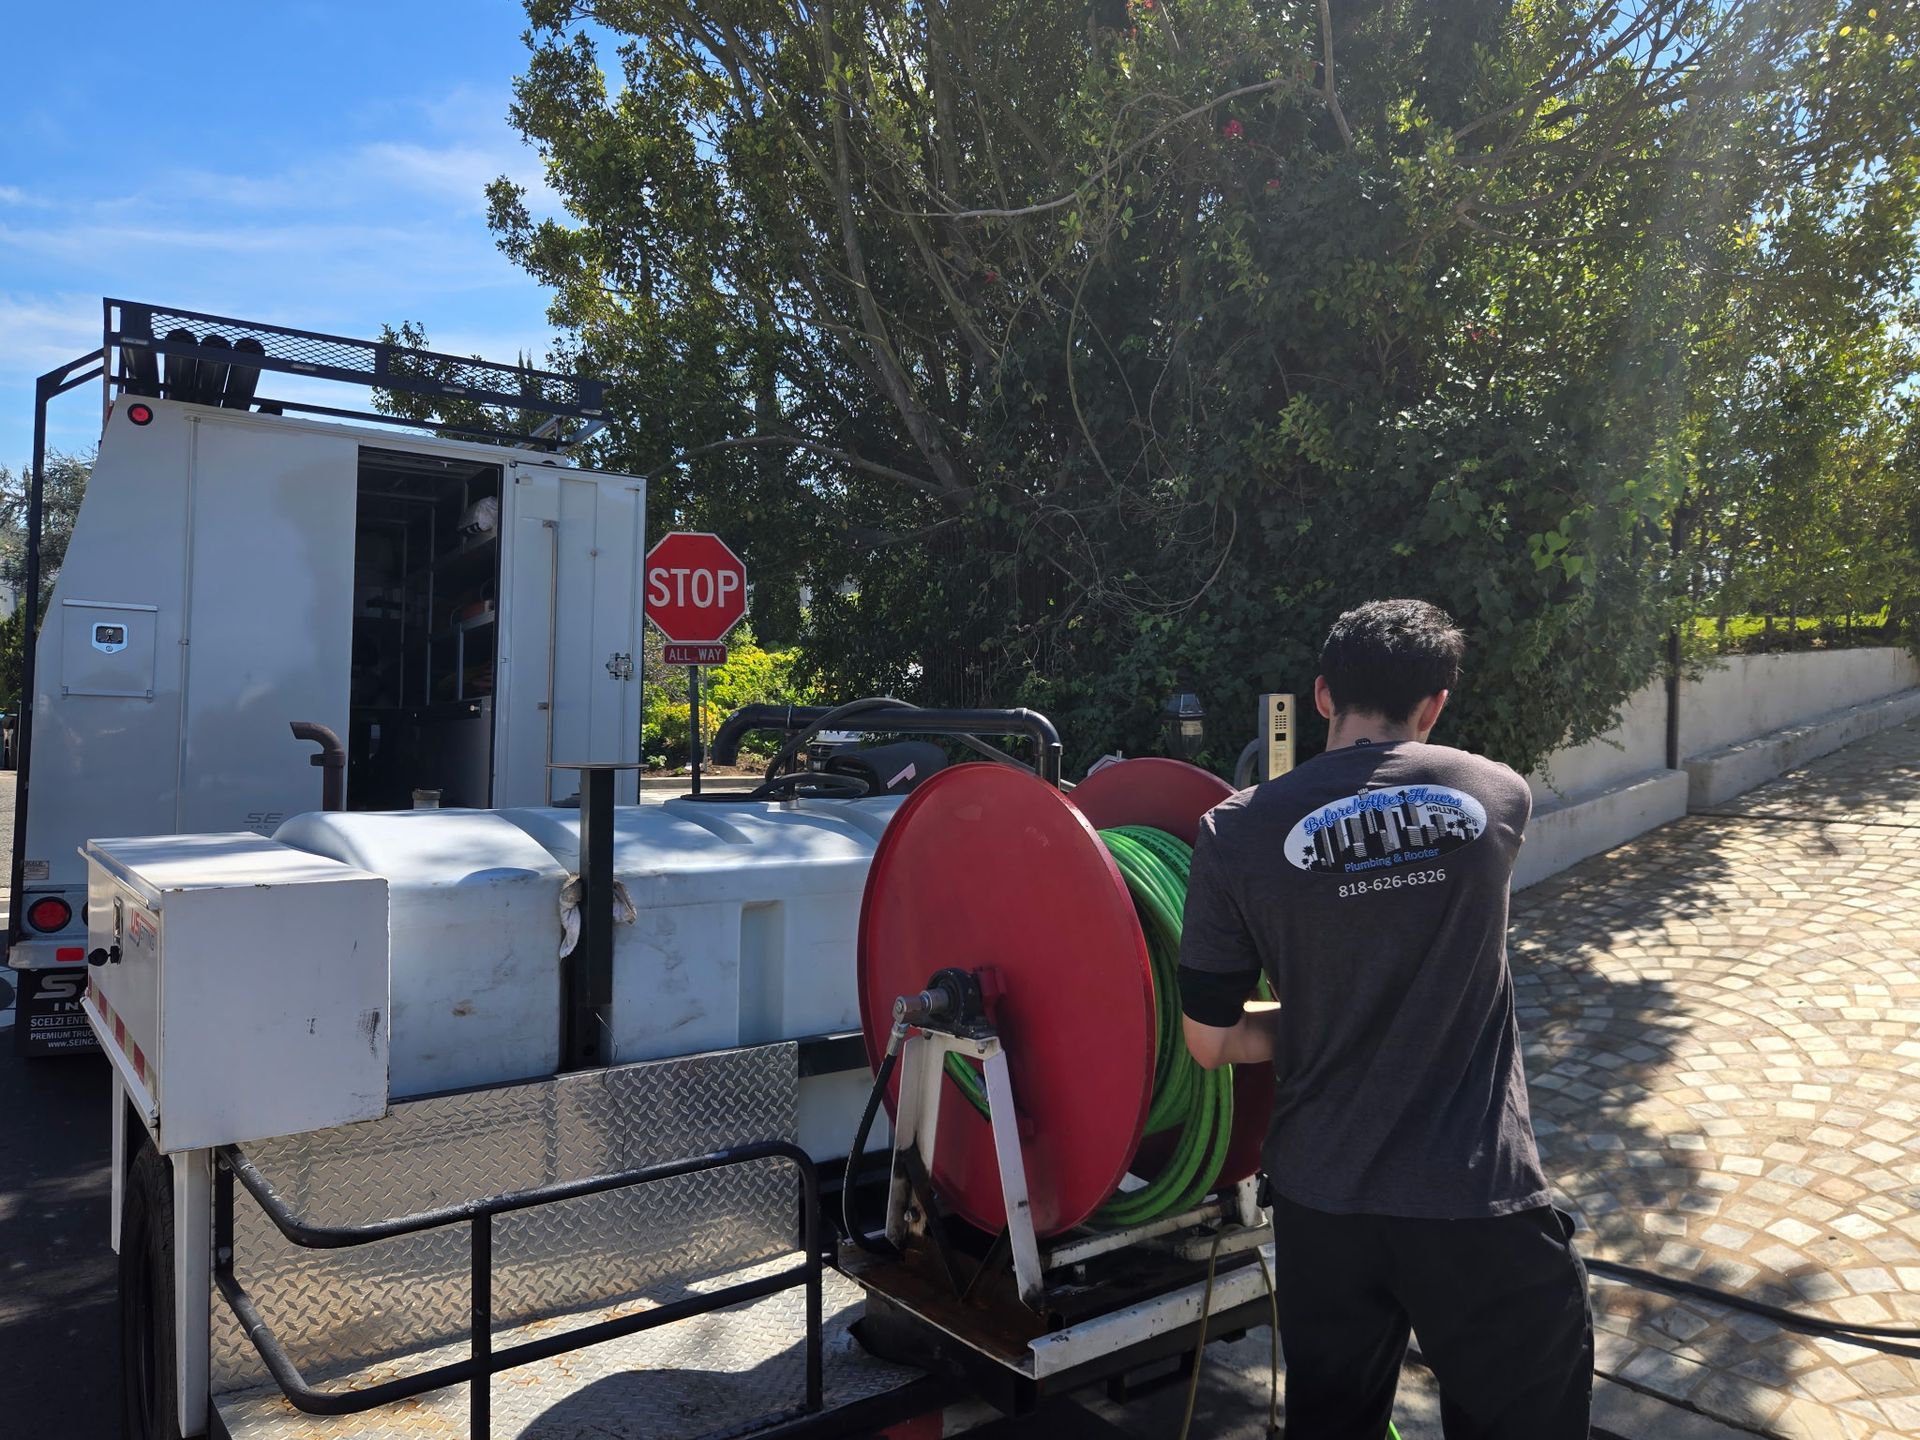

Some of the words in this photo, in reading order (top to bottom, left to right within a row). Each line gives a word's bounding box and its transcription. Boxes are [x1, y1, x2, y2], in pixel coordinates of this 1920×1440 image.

[648, 567, 739, 608] STOP
[669, 648, 691, 660] ALL
[698, 648, 722, 661] WAY
[1407, 787, 1463, 808] Hours
[243, 813, 283, 824] SE
[1426, 805, 1478, 827] HOLLYWOOD
[1344, 856, 1392, 872] Plumbing
[1393, 853, 1402, 863] &
[1403, 848, 1440, 861] Rooter
[1338, 868, 1446, 898] 818-626-6326
[30, 1017, 64, 1028] SCELZI
[30, 1031, 71, 1041] PREMIUM
